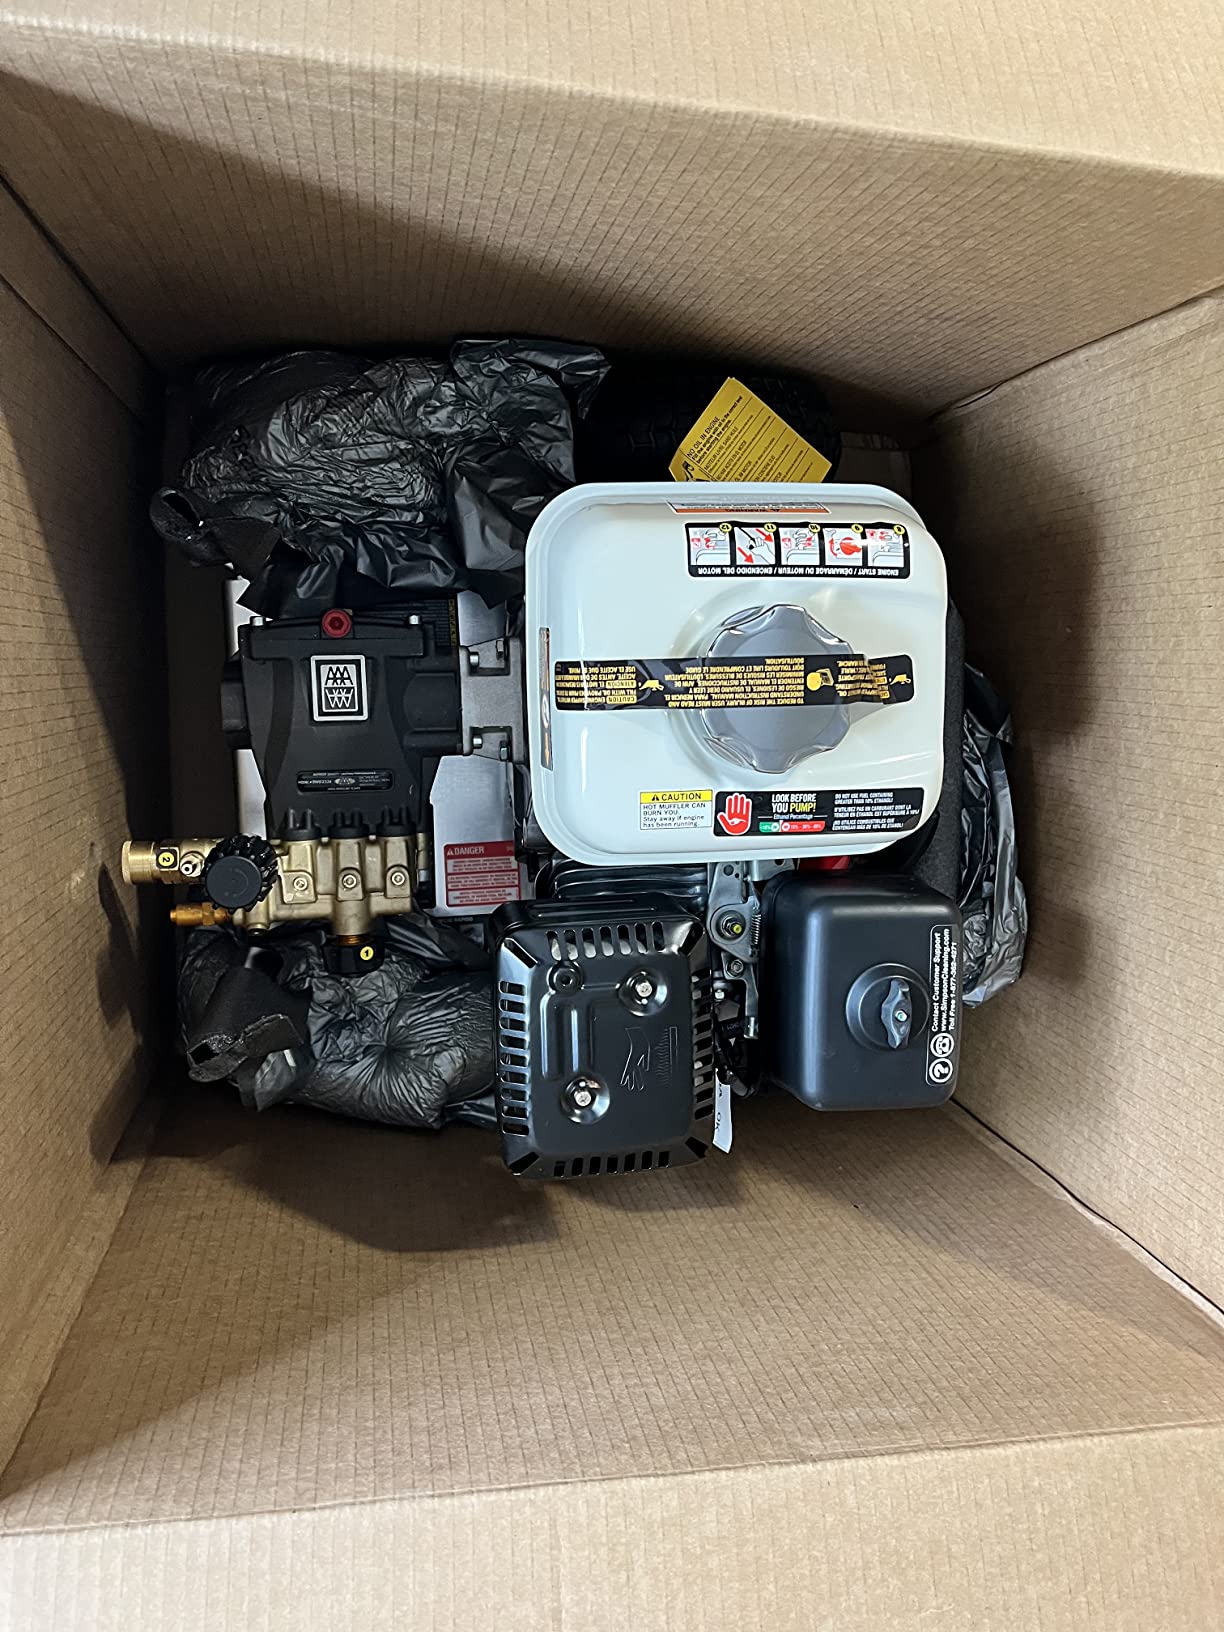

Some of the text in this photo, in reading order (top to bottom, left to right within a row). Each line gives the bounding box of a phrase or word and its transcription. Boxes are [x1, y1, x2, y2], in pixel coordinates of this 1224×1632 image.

[686, 415, 720, 458] NO OIL IN ENGINE
[736, 566, 772, 574] ENCENDIDO
[815, 567, 852, 575] DÉMARRAGE
[661, 792, 701, 800] CAUTION
[772, 793, 816, 802] LOOK BEFORE
[771, 802, 816, 812] YOU PUMP!
[454, 846, 484, 854] DANGER
[933, 932, 941, 962] Support
[940, 928, 950, 1031] www.SimpsonCleaning.com
[715, 1112, 721, 1131] OK
